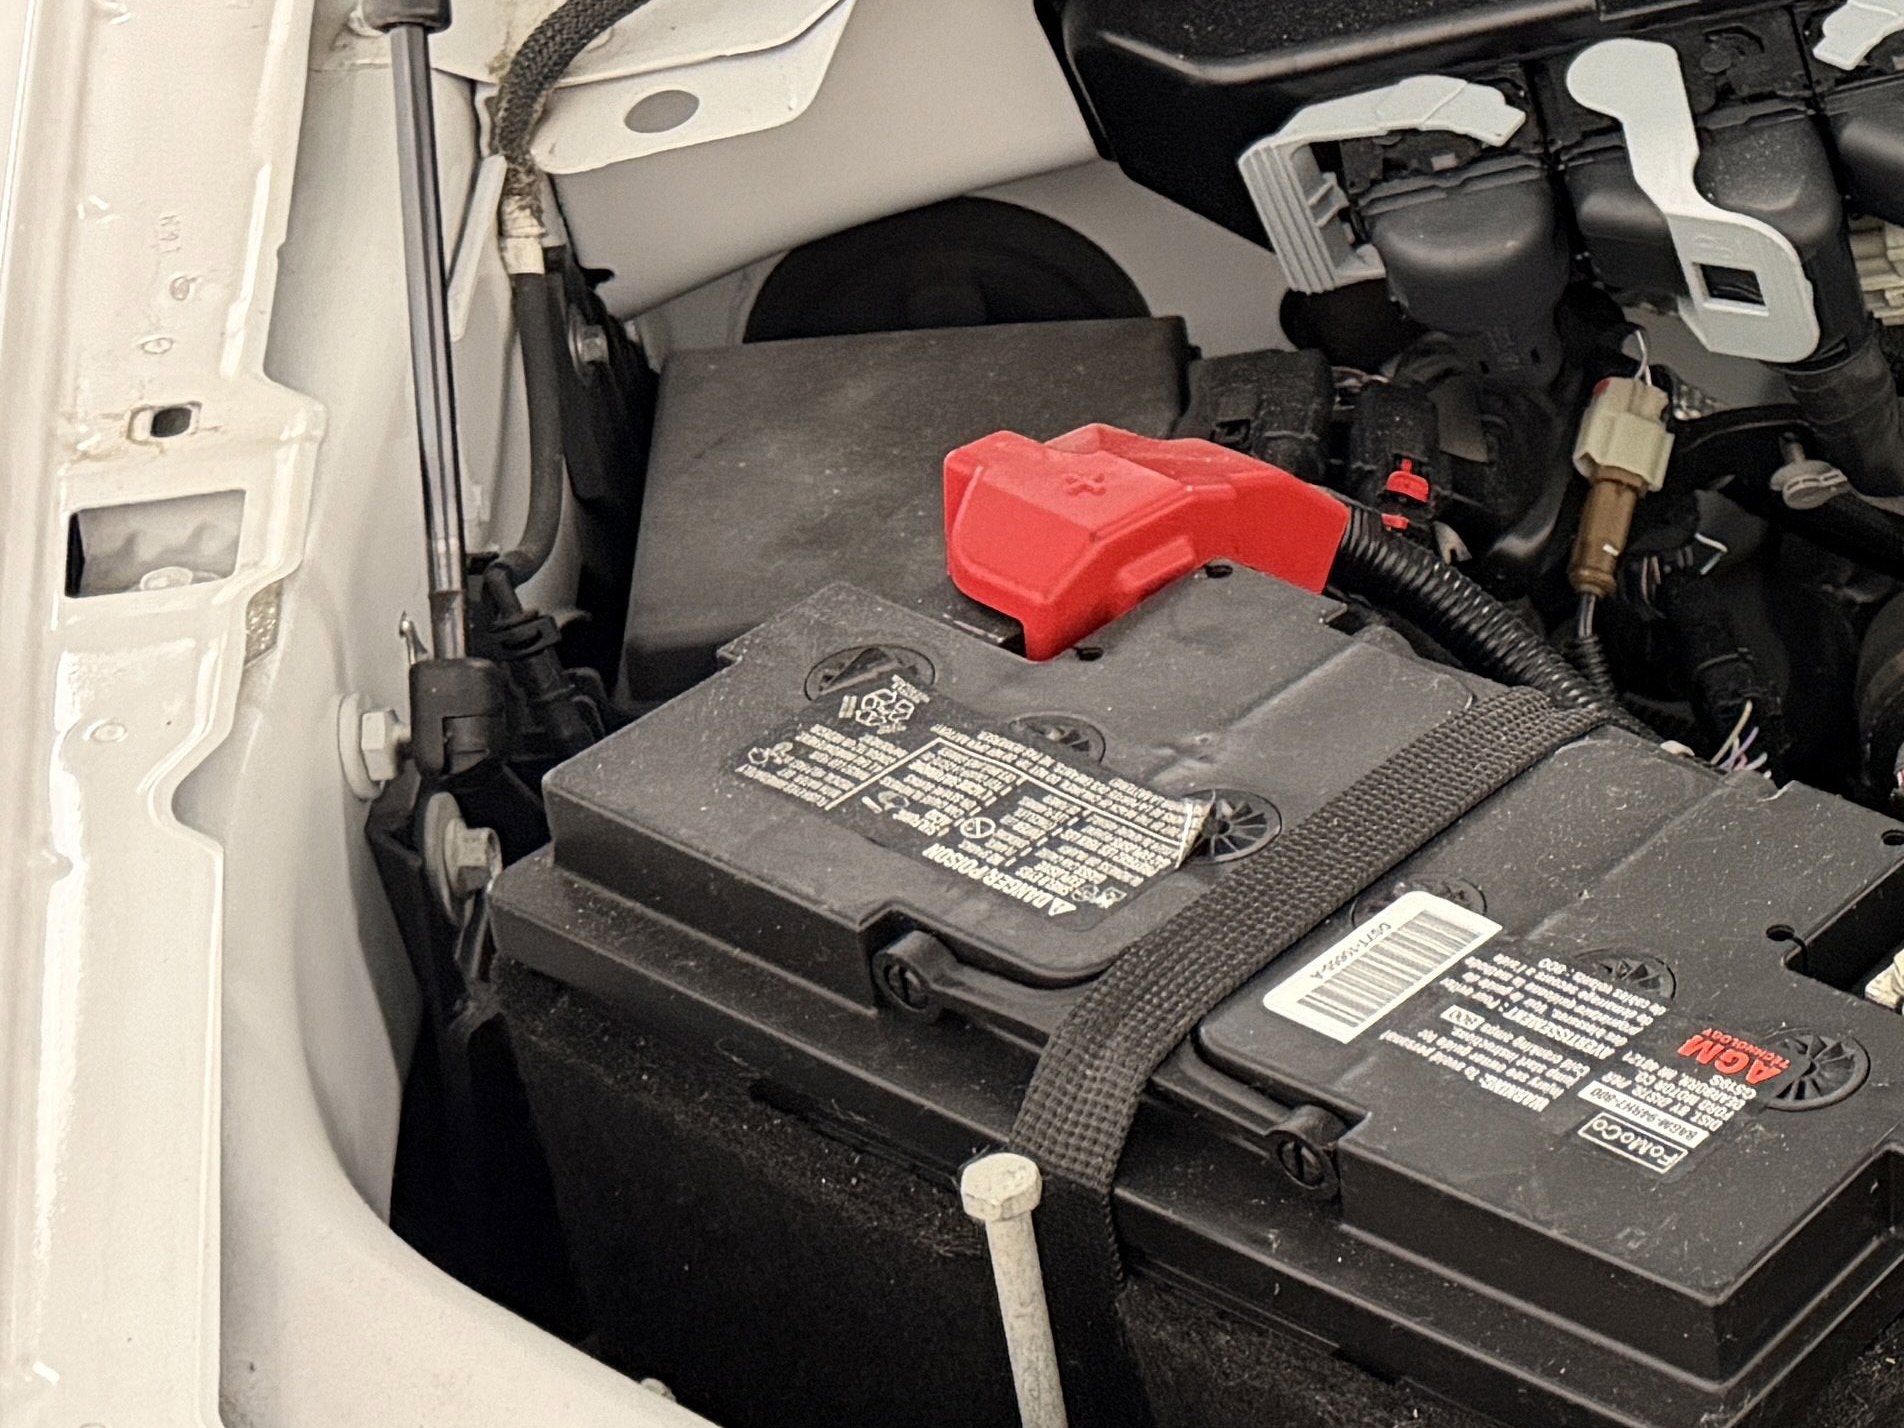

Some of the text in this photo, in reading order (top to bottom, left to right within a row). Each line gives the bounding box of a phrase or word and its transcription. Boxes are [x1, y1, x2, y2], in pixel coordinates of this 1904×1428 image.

[1673, 1033, 1783, 1088] AGM
[1700, 1026, 1795, 1068] TECHNOLOGY
[1586, 1116, 1680, 1167] FoMoCo
